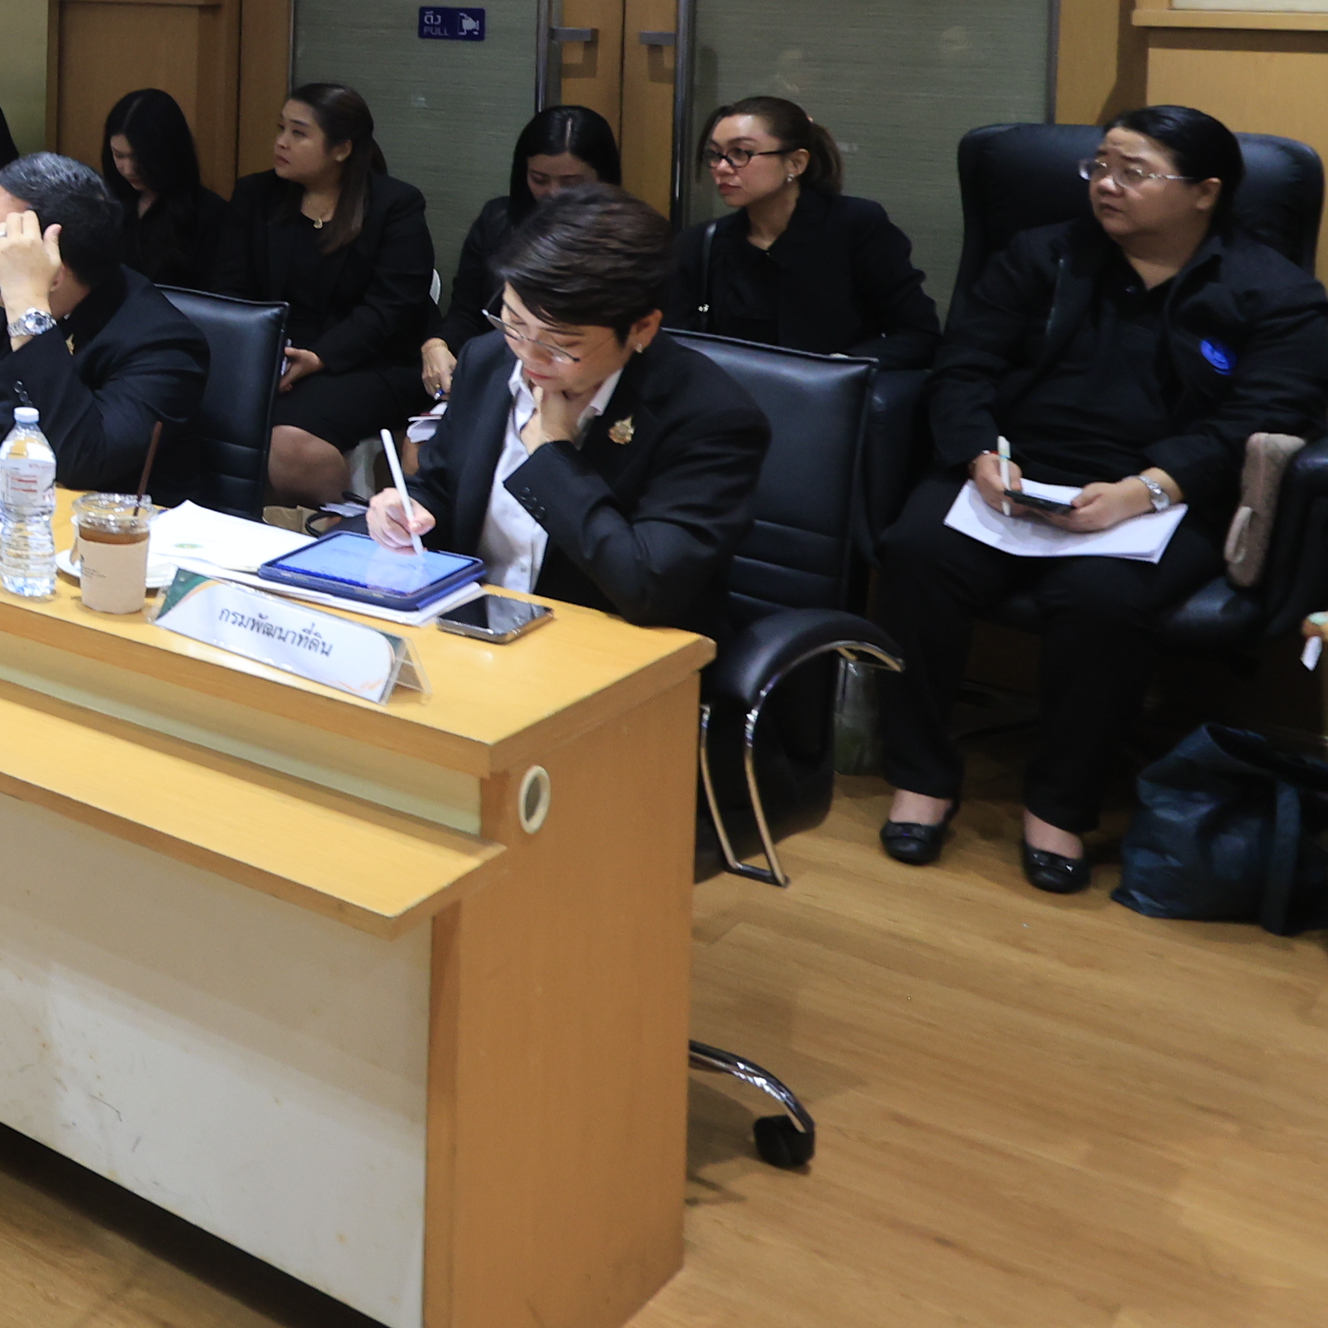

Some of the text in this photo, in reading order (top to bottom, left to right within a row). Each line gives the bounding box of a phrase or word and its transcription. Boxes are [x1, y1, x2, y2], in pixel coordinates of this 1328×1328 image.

[424, 11, 442, 25] ดึง
[424, 26, 449, 37] PULL
[218, 606, 333, 658] กรมพัฒนาที่ดิน
